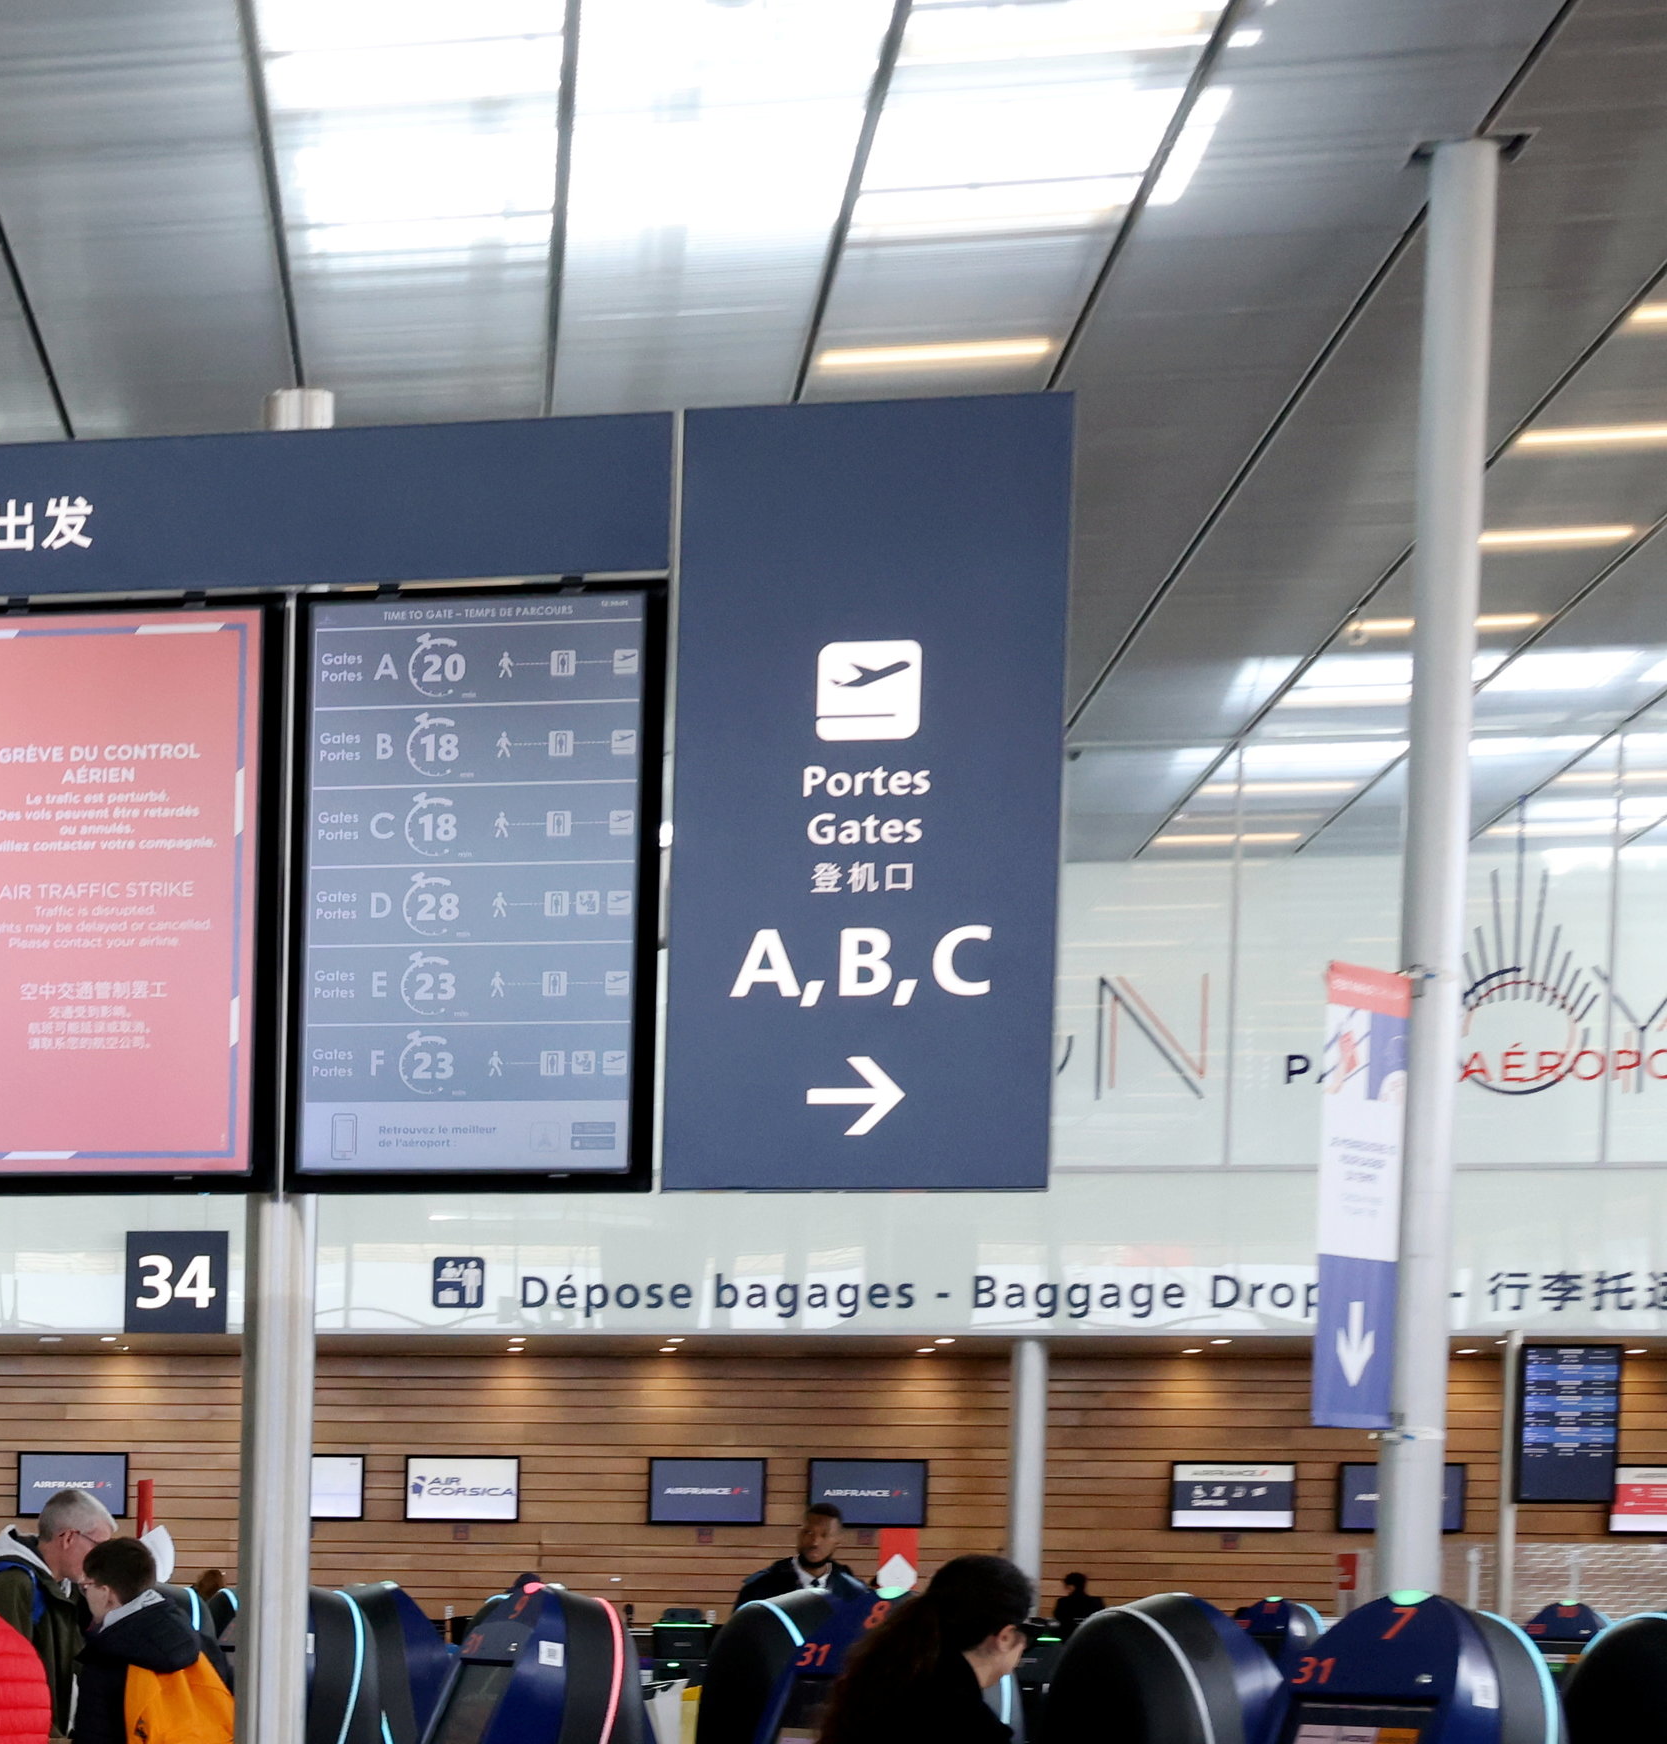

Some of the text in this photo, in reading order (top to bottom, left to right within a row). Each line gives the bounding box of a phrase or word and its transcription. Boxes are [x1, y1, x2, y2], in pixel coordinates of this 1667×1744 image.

[383, 605, 573, 621] TIME TO GATE TEMPS DE PARCOURS
[321, 653, 363, 666] Gates
[373, 653, 399, 681] A
[422, 653, 466, 682] 20
[321, 670, 363, 683] Portes
[319, 732, 361, 746] Gates
[376, 733, 394, 760] B
[420, 733, 459, 762] 18
[69, 745, 98, 762] DU
[104, 743, 201, 761] CONTROL
[319, 749, 361, 762] Portes
[61, 765, 135, 784] AÉRIEN
[803, 765, 931, 797] Portes
[26, 793, 40, 805] Le
[46, 792, 80, 804] trafic
[84, 792, 104, 803] est
[26, 808, 51, 820] vols
[55, 807, 109, 821] peuvent
[143, 805, 200, 818] retardés
[318, 812, 359, 824] Gates
[59, 825, 76, 835] ou
[370, 812, 395, 839] C
[418, 813, 457, 841] 18
[807, 812, 923, 845] Gates
[318, 829, 359, 841] Portes
[33, 840, 95, 852] contacter
[100, 839, 135, 849] votre
[810, 861, 914, 893] 登机口
[37, 882, 120, 899] TRAFFIC
[126, 881, 195, 898] STRIKE
[316, 891, 357, 903] Gates
[35, 905, 74, 918] Traffic
[78, 905, 88, 917] is
[316, 908, 357, 920] Portes
[370, 892, 392, 919] D
[417, 893, 459, 921] 28
[26, 923, 51, 935] may
[56, 921, 72, 933] be
[76, 920, 127, 934] delayed
[131, 922, 145, 932] or
[9, 937, 135, 949] Please contact your
[729, 924, 993, 1007] A,B,C
[314, 970, 355, 982] Gates
[371, 971, 387, 998] E
[20, 981, 168, 1000] 空中交通管制罢工
[314, 987, 355, 999] Portes
[414, 972, 456, 1001] 23
[312, 1048, 353, 1061] Gates
[312, 1065, 353, 1078] Portes
[370, 1050, 385, 1077] F
[412, 1051, 454, 1079] 23
[379, 1124, 497, 1135] Retrouvez le meilleur
[379, 1138, 450, 1150] de l'aéroport
[135, 1254, 217, 1309] 34
[520, 1274, 693, 1318] Dépose
[715, 1274, 915, 1319] bagages
[972, 1274, 1187, 1319] Baggage
[33, 1480, 95, 1489] AIRFRANCE
[427, 1476, 461, 1487] AIR
[426, 1487, 515, 1497] CORSICA
[664, 1487, 732, 1496] AIRFRANCE
[823, 1489, 891, 1498] AIRFRANCE
[508, 1596, 529, 1620] 9
[864, 1600, 892, 1628] 8
[1380, 1607, 1418, 1640] 7
[795, 1643, 832, 1667] 31
[1292, 1656, 1337, 1685] 31
